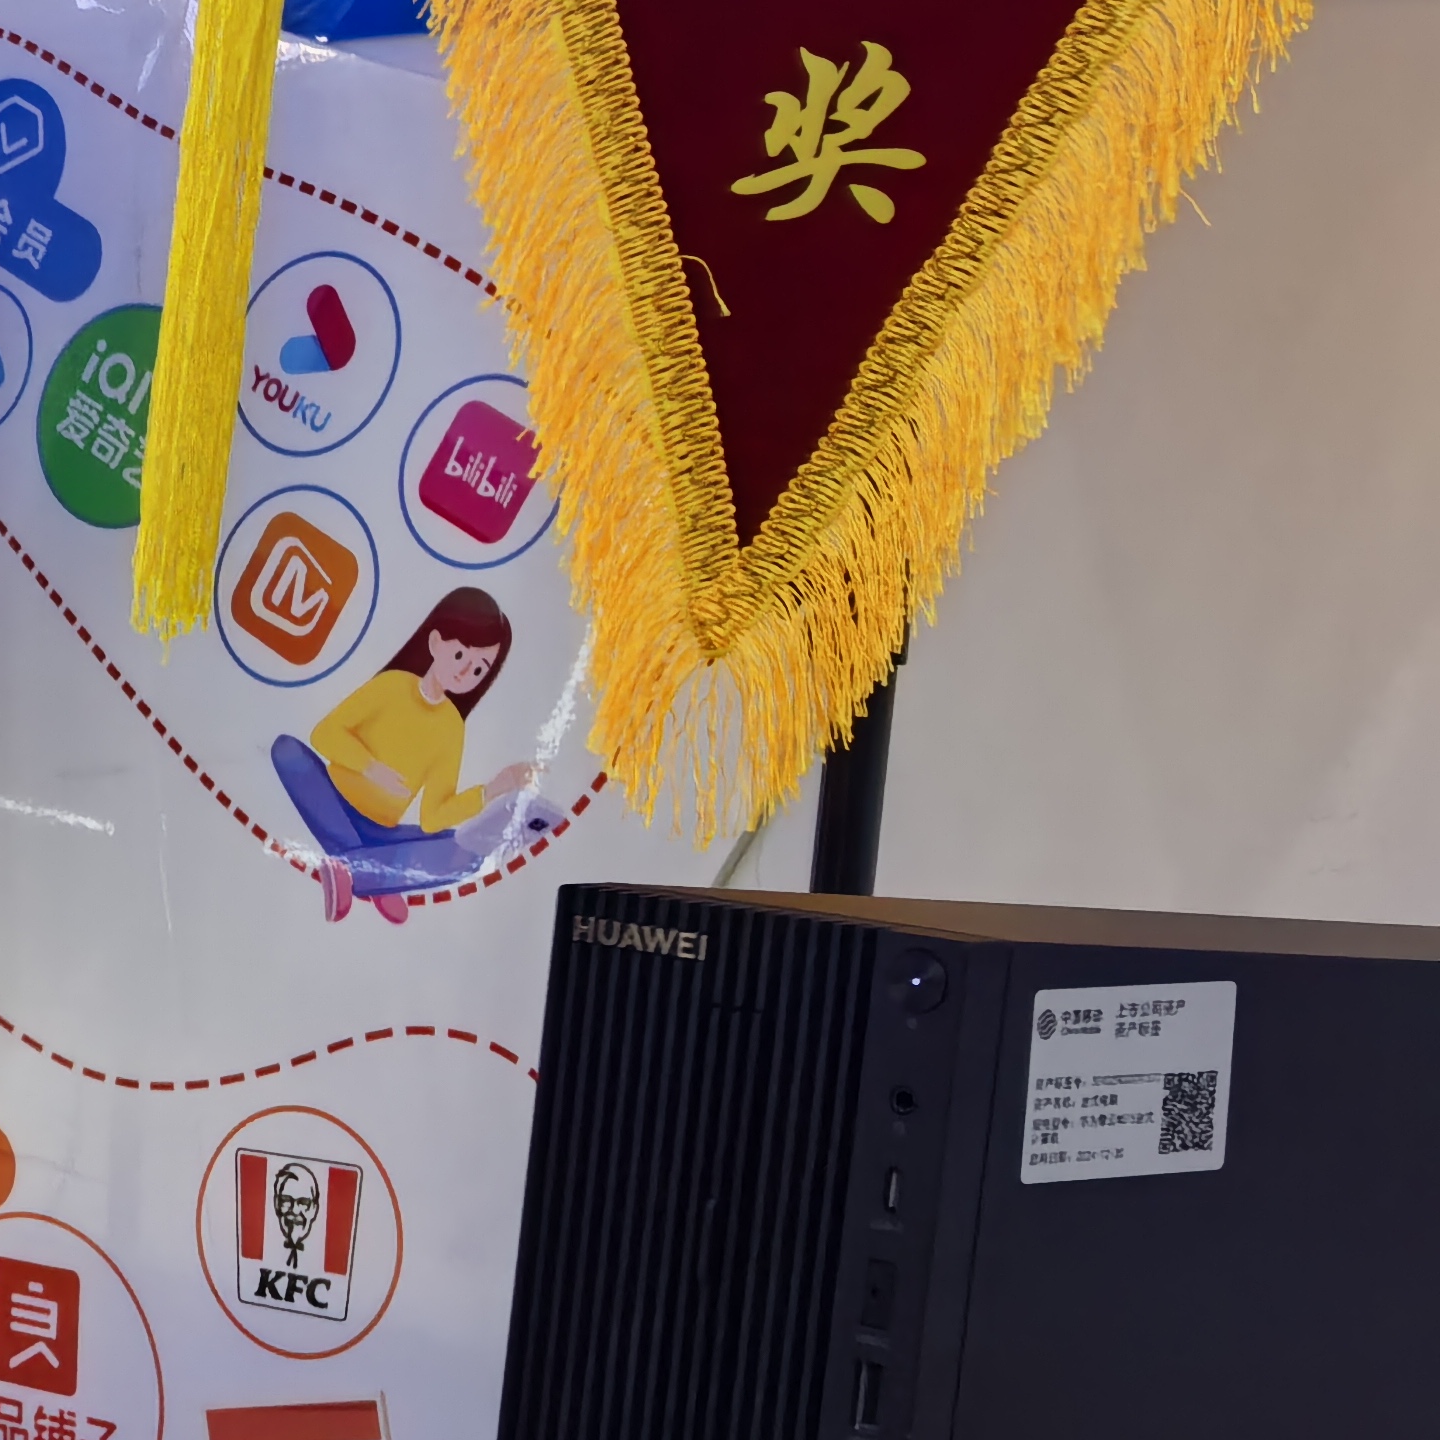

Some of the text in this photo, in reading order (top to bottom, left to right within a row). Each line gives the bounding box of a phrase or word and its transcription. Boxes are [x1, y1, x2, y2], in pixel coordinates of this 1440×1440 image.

[82, 339, 153, 415] iQI
[250, 365, 333, 434] YOUKU
[443, 436, 519, 509] bilibili
[572, 915, 709, 962] HUAWEI
[253, 1268, 332, 1312] KFC
